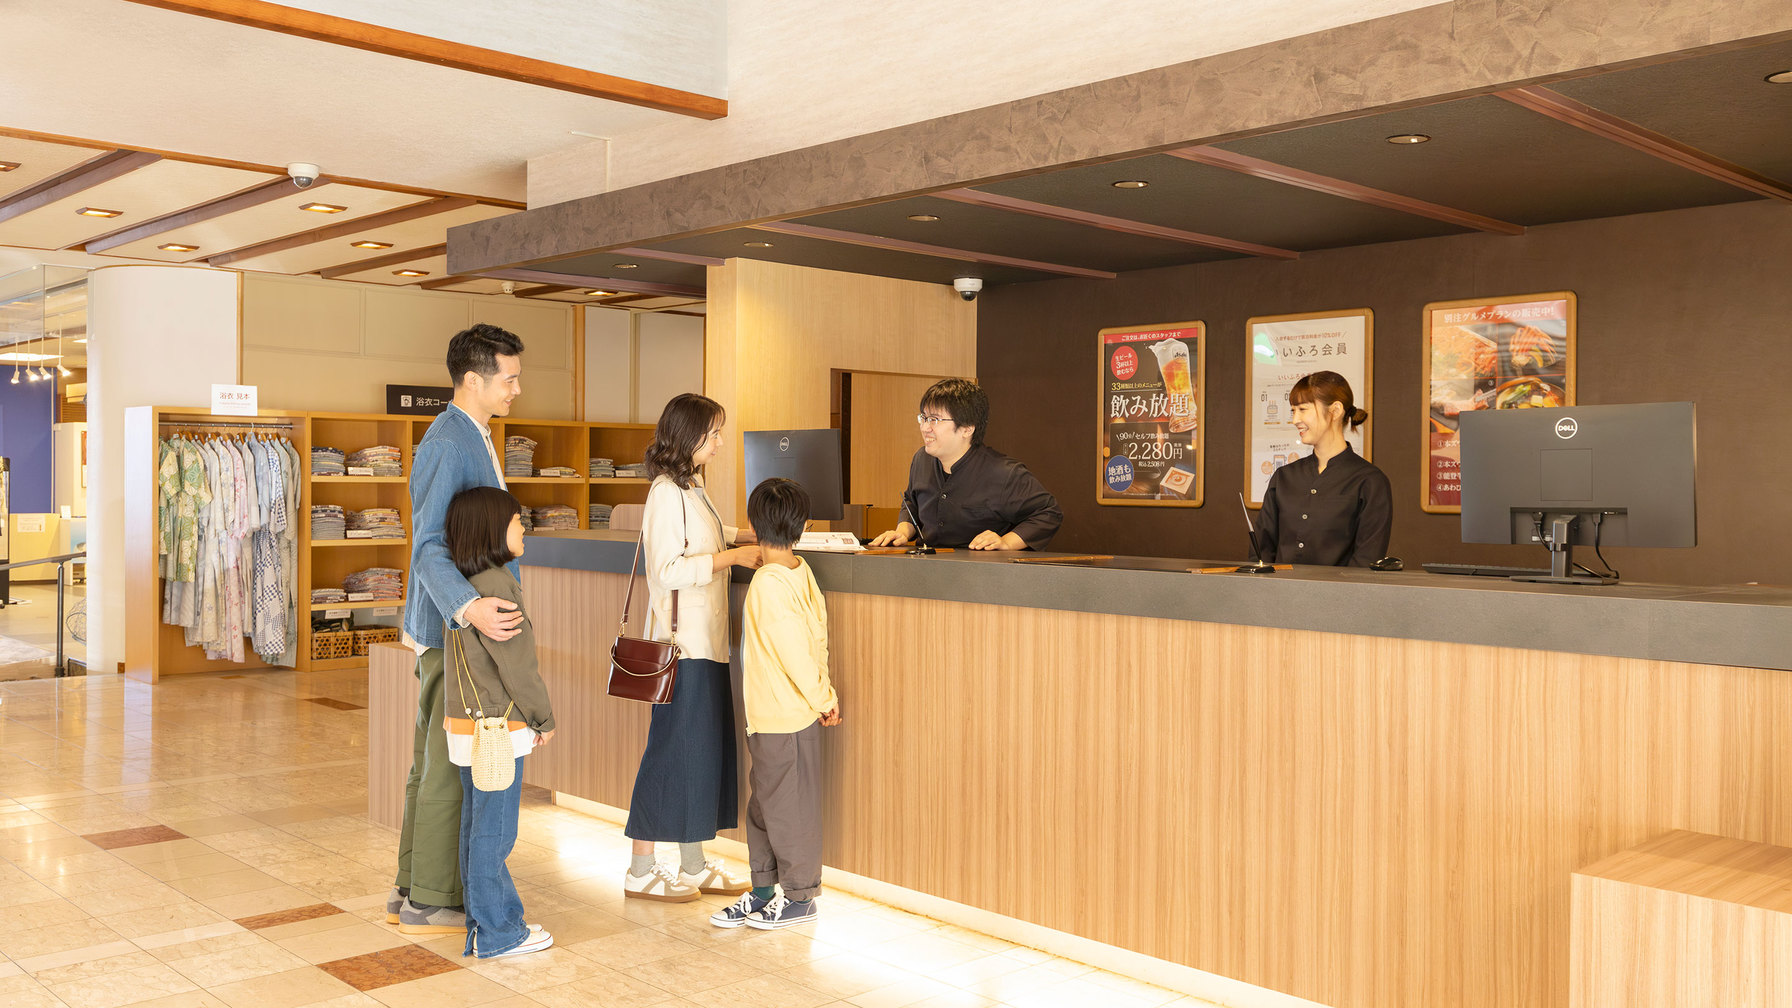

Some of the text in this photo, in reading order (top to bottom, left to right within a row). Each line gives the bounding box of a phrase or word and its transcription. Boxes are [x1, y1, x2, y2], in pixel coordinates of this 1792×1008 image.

[1110, 393, 1190, 418] 飲み放題
[1437, 440, 1460, 448] ①本ズ
[1128, 442, 1183, 460] 2,280円
[1108, 464, 1131, 476] 地酒も
[1109, 474, 1132, 484] 飲み放題
